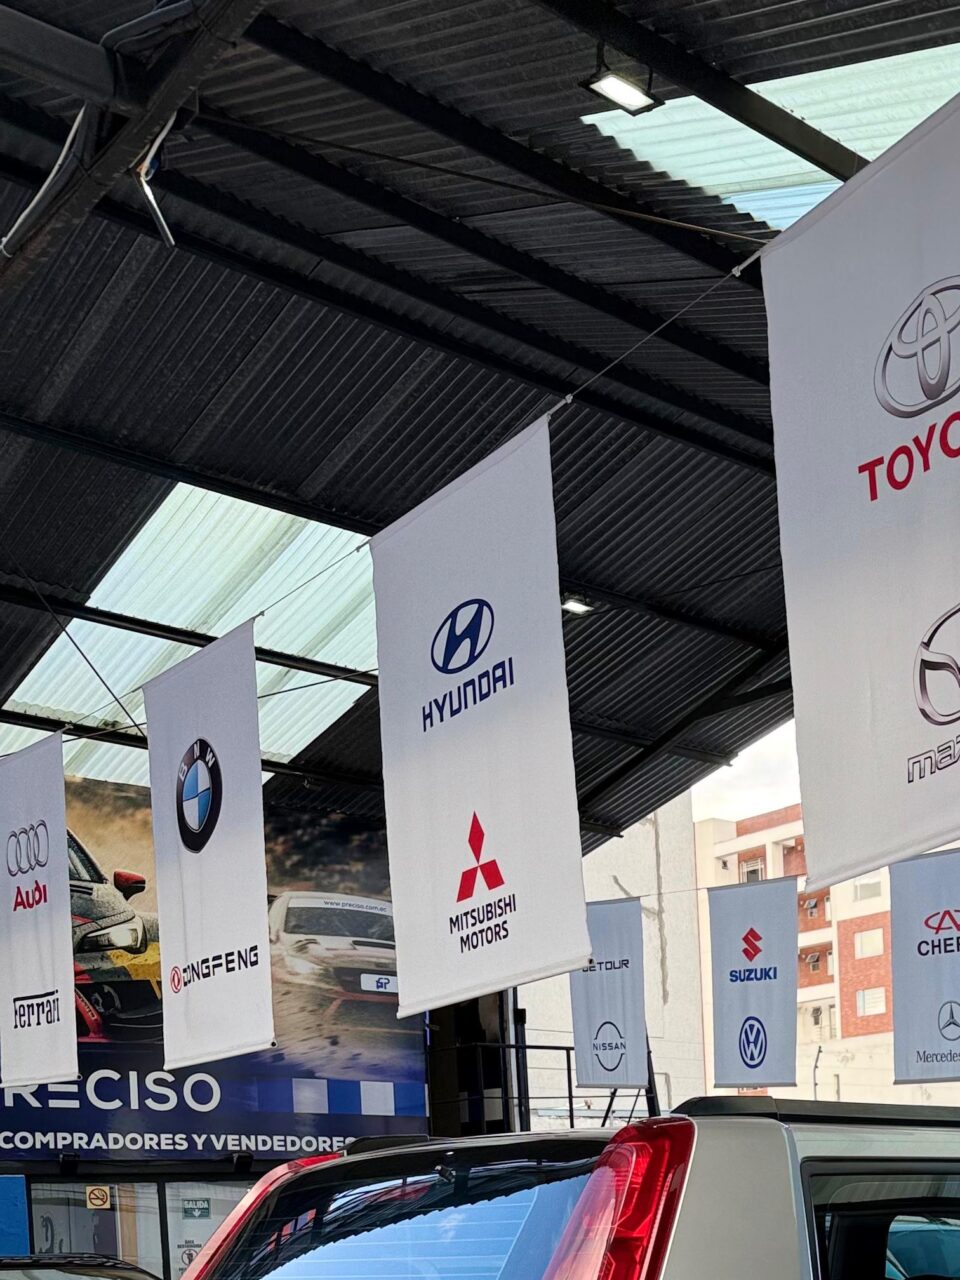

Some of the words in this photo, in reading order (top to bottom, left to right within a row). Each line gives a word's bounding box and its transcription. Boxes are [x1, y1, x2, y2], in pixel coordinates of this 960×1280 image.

[422, 657, 515, 732] HYUNDAI
[13, 880, 48, 912] Audi
[449, 893, 517, 935] MITSUBISHI
[460, 919, 509, 953] MOTORS
[182, 945, 259, 987] DONGFENG
[729, 966, 777, 983] SUZUKI
[13, 989, 60, 1029] Ferrari
[592, 1042, 626, 1051] NISSAN
[0, 1131, 189, 1151] COMPRADORES
[191, 1134, 207, 1150] Y
[184, 1200, 209, 1209] SALIDA
